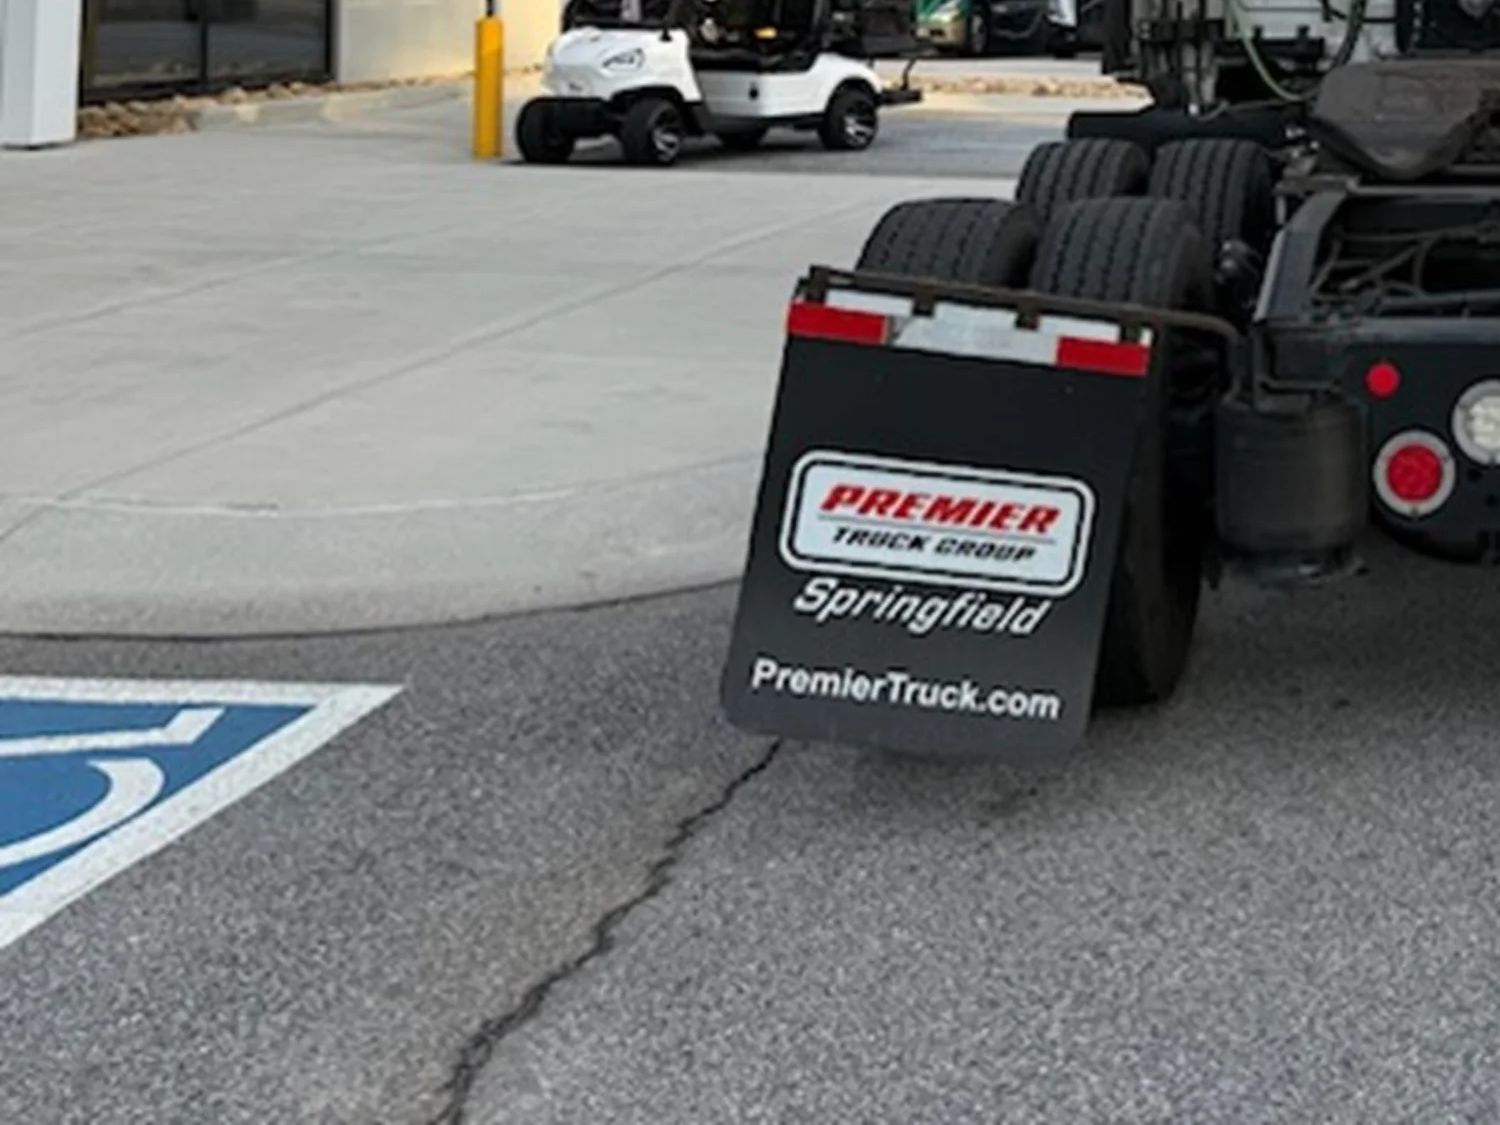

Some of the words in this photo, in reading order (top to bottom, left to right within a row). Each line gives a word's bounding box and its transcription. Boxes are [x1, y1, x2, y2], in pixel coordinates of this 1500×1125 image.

[821, 484, 1061, 534] PREMIER
[832, 526, 927, 554] TRUCK
[935, 538, 1038, 563] GROUP
[793, 578, 1052, 635] Springfield
[751, 658, 1062, 720] PremierTruck.com
